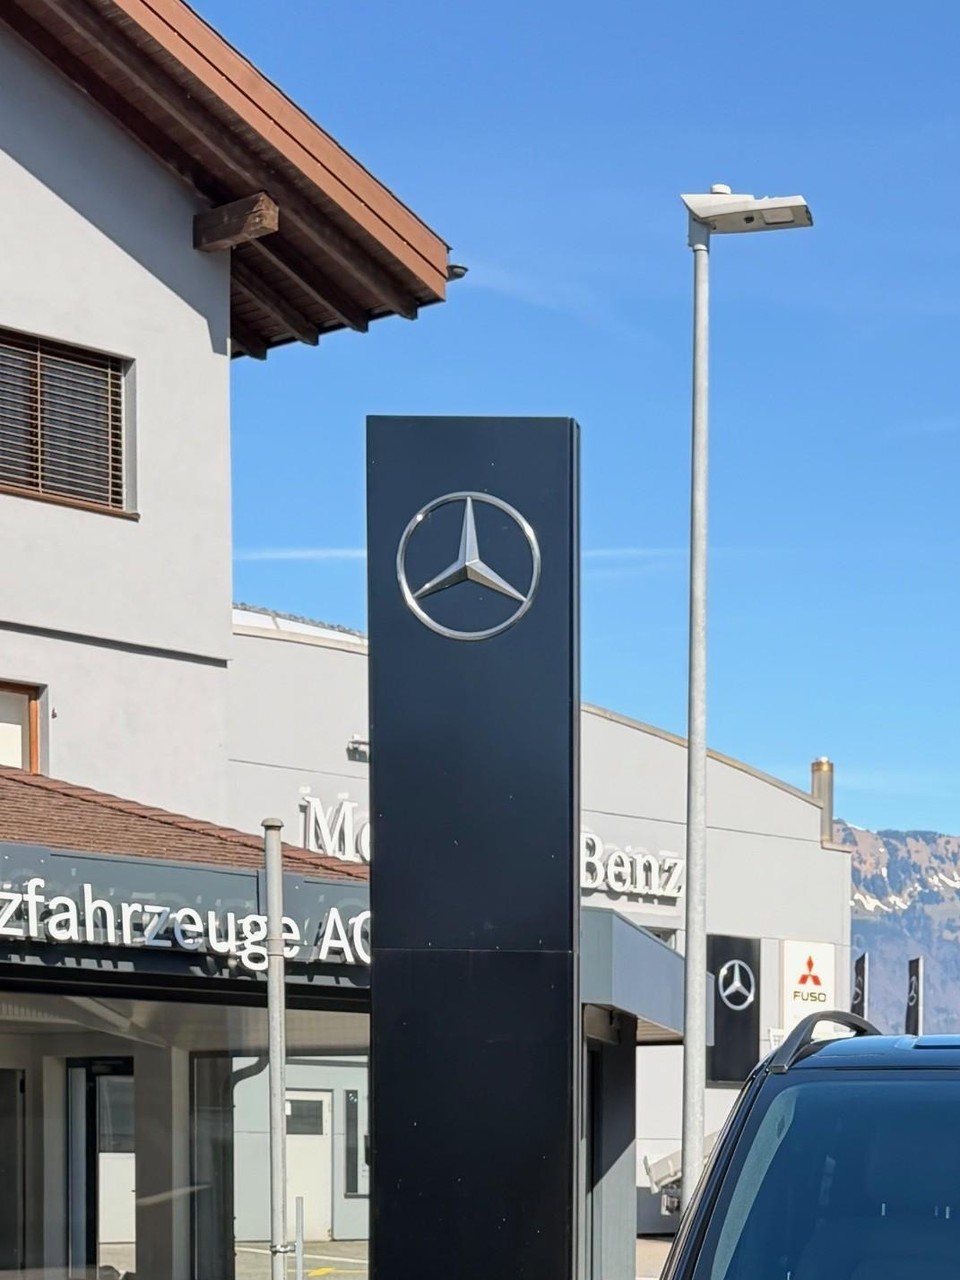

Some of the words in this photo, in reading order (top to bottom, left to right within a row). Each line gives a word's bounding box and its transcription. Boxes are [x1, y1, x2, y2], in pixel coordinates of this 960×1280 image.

[580, 832, 684, 898] Benz
[0, 877, 301, 971] zfahrzeuge
[793, 990, 827, 1003] FUSO
